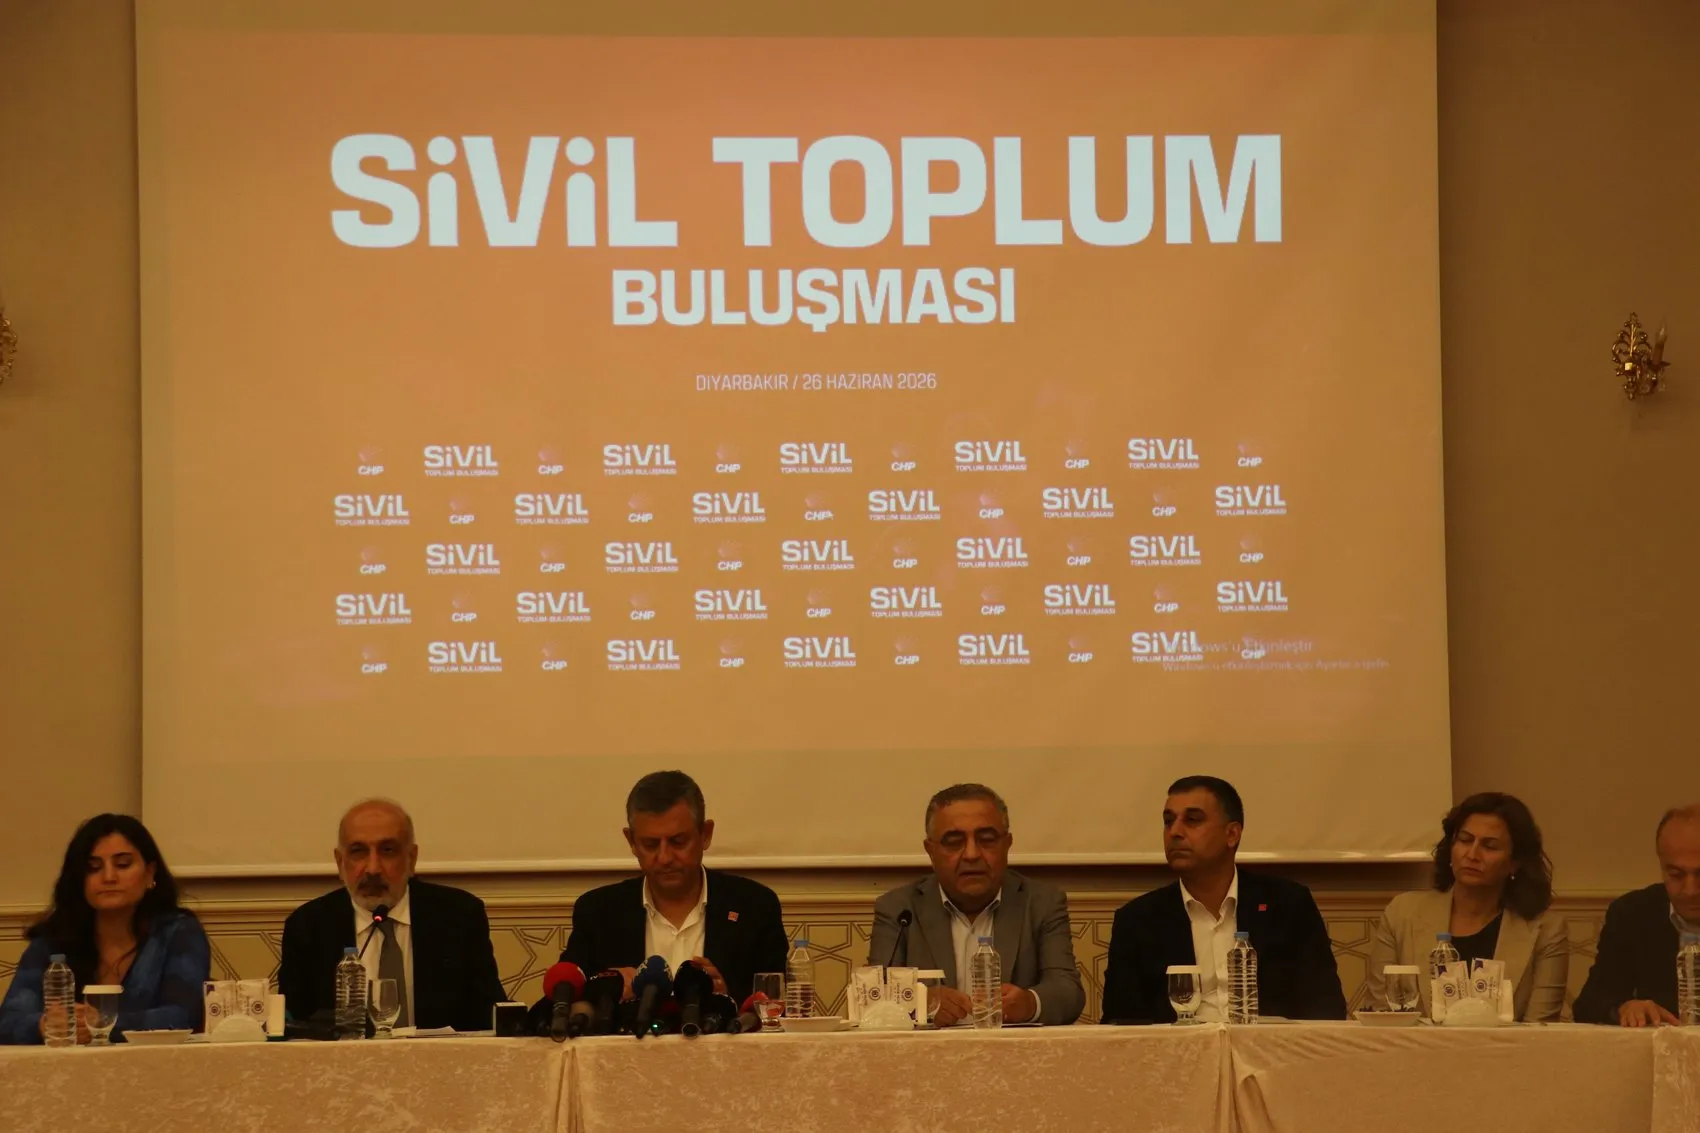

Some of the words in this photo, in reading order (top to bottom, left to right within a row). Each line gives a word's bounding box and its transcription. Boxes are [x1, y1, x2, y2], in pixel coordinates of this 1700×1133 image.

[713, 133, 1283, 247] TOPLUM
[611, 267, 1015, 332] BULUŞMASI
[792, 374, 799, 391] /
[802, 373, 822, 390] 26
[897, 372, 938, 389] 2026
[891, 460, 916, 471] CHP
[1065, 457, 1089, 468] CHP
[1237, 455, 1262, 466] CHP
[358, 464, 384, 475] CHP
[538, 463, 564, 474] CHP
[716, 461, 741, 472] CHP
[804, 509, 831, 520] CHP
[979, 509, 1004, 520] CHP
[1152, 505, 1176, 516] CHP
[449, 512, 475, 523] CHP
[628, 511, 653, 522] CHP
[893, 556, 917, 567] CHP
[1067, 554, 1091, 565] CHP
[1240, 552, 1264, 563] CHP
[360, 563, 386, 574] CHP
[540, 561, 565, 572] CHP
[717, 559, 743, 570] CHP
[806, 606, 832, 617] CHP
[981, 603, 1005, 614] CHP
[1154, 602, 1179, 613] CHP
[452, 611, 477, 622] CHP
[630, 608, 655, 619] CHP
[720, 656, 744, 667] CHP
[895, 653, 920, 664] CHP
[1068, 651, 1093, 662] CHP
[361, 662, 387, 673] CHP
[541, 659, 567, 670] CHP
